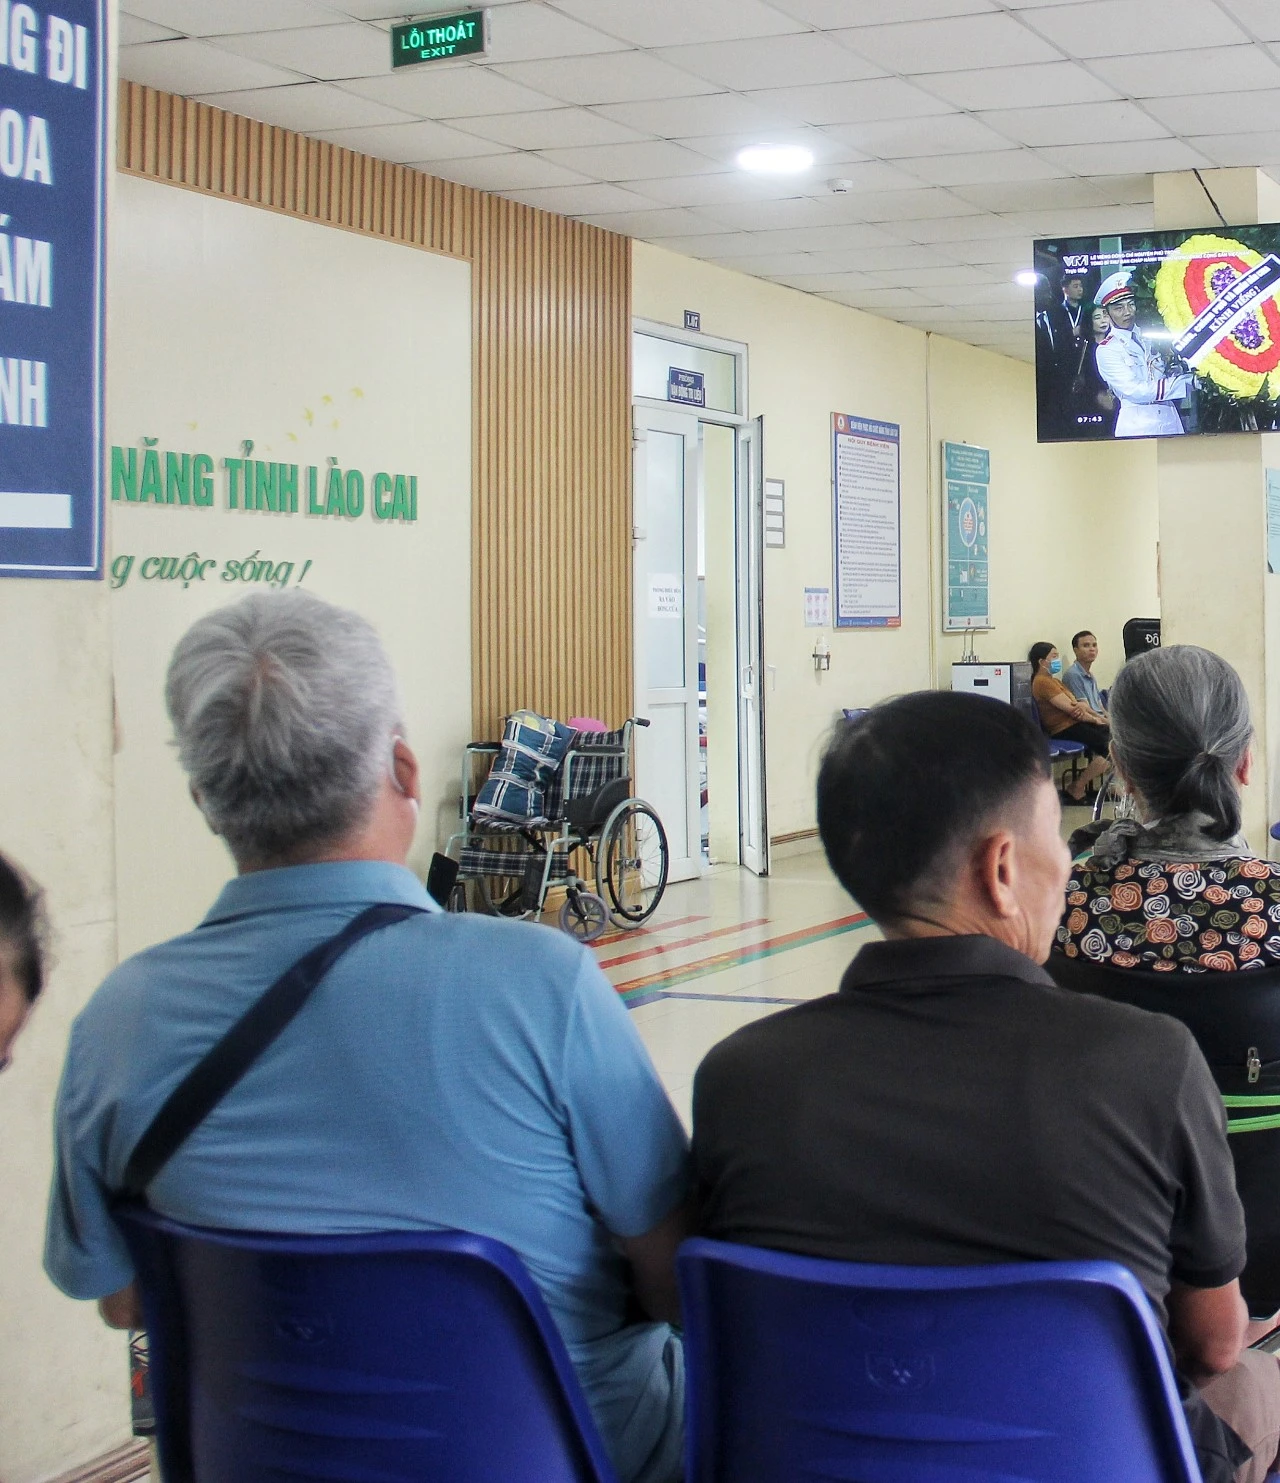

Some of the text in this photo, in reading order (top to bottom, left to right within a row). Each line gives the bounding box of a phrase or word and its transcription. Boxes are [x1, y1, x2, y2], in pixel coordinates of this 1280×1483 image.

[426, 20, 476, 45] THOÁT
[47, 14, 88, 90] ĐI
[421, 45, 456, 58] EXIT
[1077, 415, 1102, 423] 07:43
[111, 436, 418, 522] NĂNG TỈNH LÀO CAI
[141, 551, 217, 589] cuộc
[221, 550, 295, 588] sống
[298, 559, 313, 583] !
